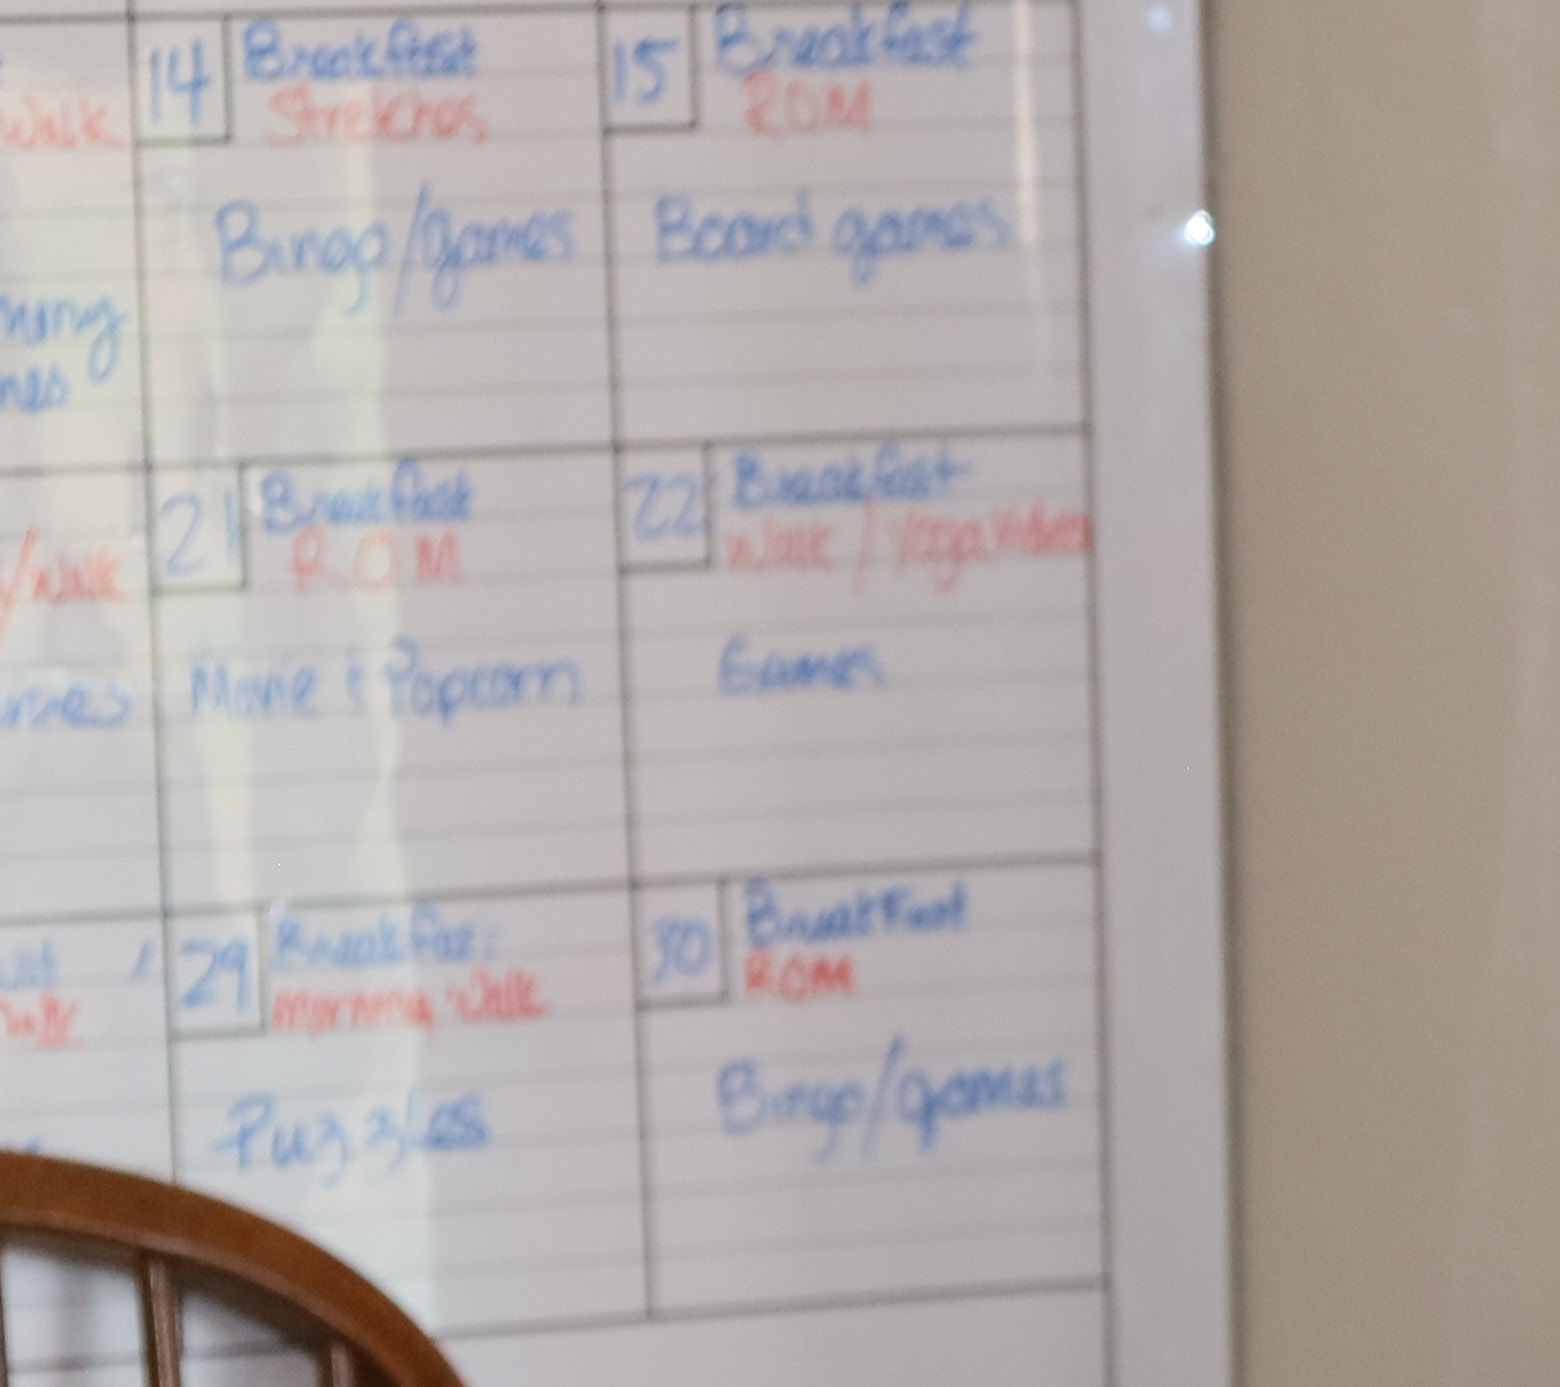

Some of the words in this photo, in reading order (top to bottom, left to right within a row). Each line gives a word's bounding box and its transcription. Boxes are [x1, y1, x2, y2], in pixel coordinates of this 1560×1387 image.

[241, 18, 478, 82] Breakfast
[610, 38, 680, 104] 15
[714, 2, 976, 76] Breakfast
[149, 38, 211, 124] 14
[655, 190, 812, 266] Board
[832, 198, 1016, 288] games
[260, 458, 473, 536] Breakfast
[622, 472, 703, 541] 22
[732, 443, 972, 508] Breakfast
[160, 492, 240, 578] 21
[290, 522, 462, 596] ROM
[190, 660, 320, 718] Movie
[384, 634, 583, 728] Popcorn
[178, 938, 250, 1012] 29
[654, 914, 714, 984] 30
[744, 945, 858, 1004] ROM
